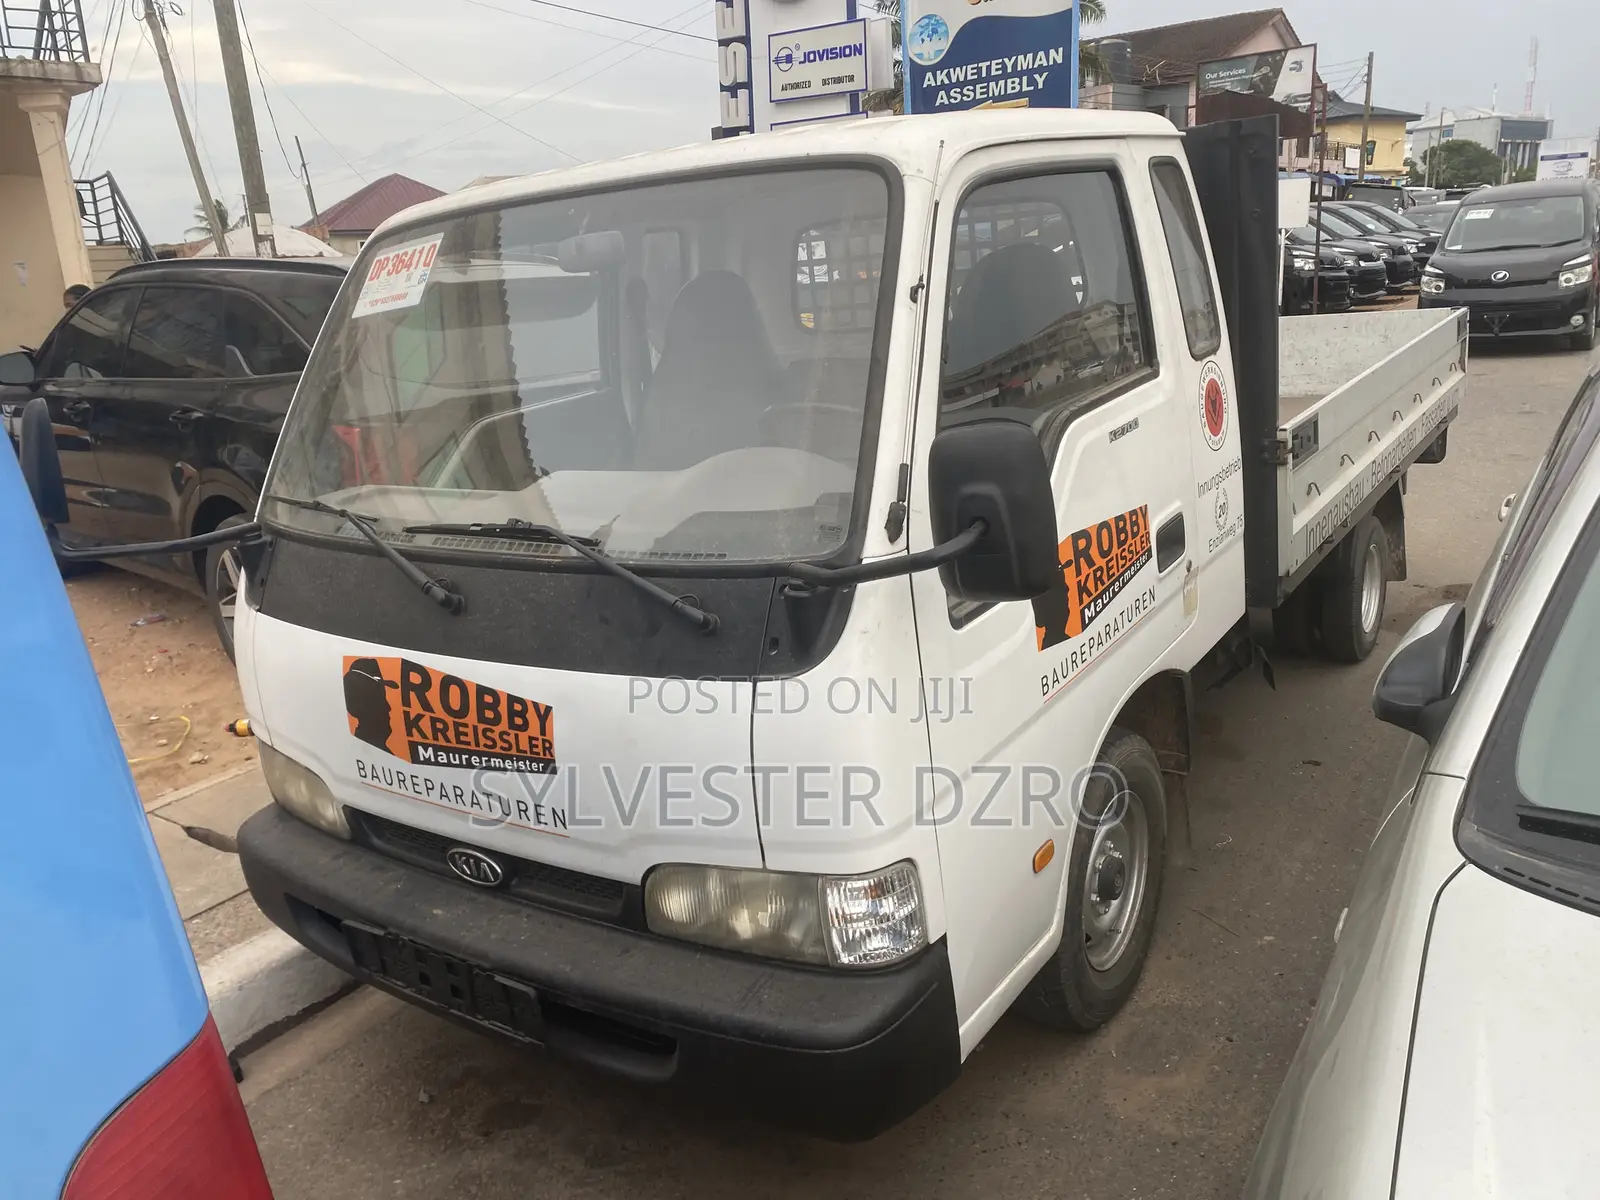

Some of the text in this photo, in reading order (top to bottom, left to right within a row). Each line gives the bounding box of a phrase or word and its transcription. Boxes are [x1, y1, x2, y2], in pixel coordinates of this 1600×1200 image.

[799, 43, 862, 64] JOVISION
[922, 47, 1064, 88] AKWETEYMAN
[1205, 68, 1247, 80] Our Services
[781, 74, 855, 92] AUTHORIZED DISTRIBUTOR
[935, 72, 1049, 107] ASSEMBLY
[1109, 417, 1139, 443] K2700
[1197, 455, 1242, 498] Innungsbetrieb
[1218, 501, 1226, 519] 20
[1305, 477, 1365, 558] Innenausbau
[1071, 504, 1148, 578] ROBBY
[1076, 531, 1151, 607] KREISSLER
[1084, 552, 1149, 624] Maurermeister
[1040, 585, 1156, 697] BAUREPARATUREN
[400, 658, 553, 737] ROBBY
[402, 709, 555, 758] KREISSLER
[416, 744, 545, 772] Maurermeister
[355, 758, 569, 831] BAUREPARATUREN
[453, 852, 496, 882] KIA
